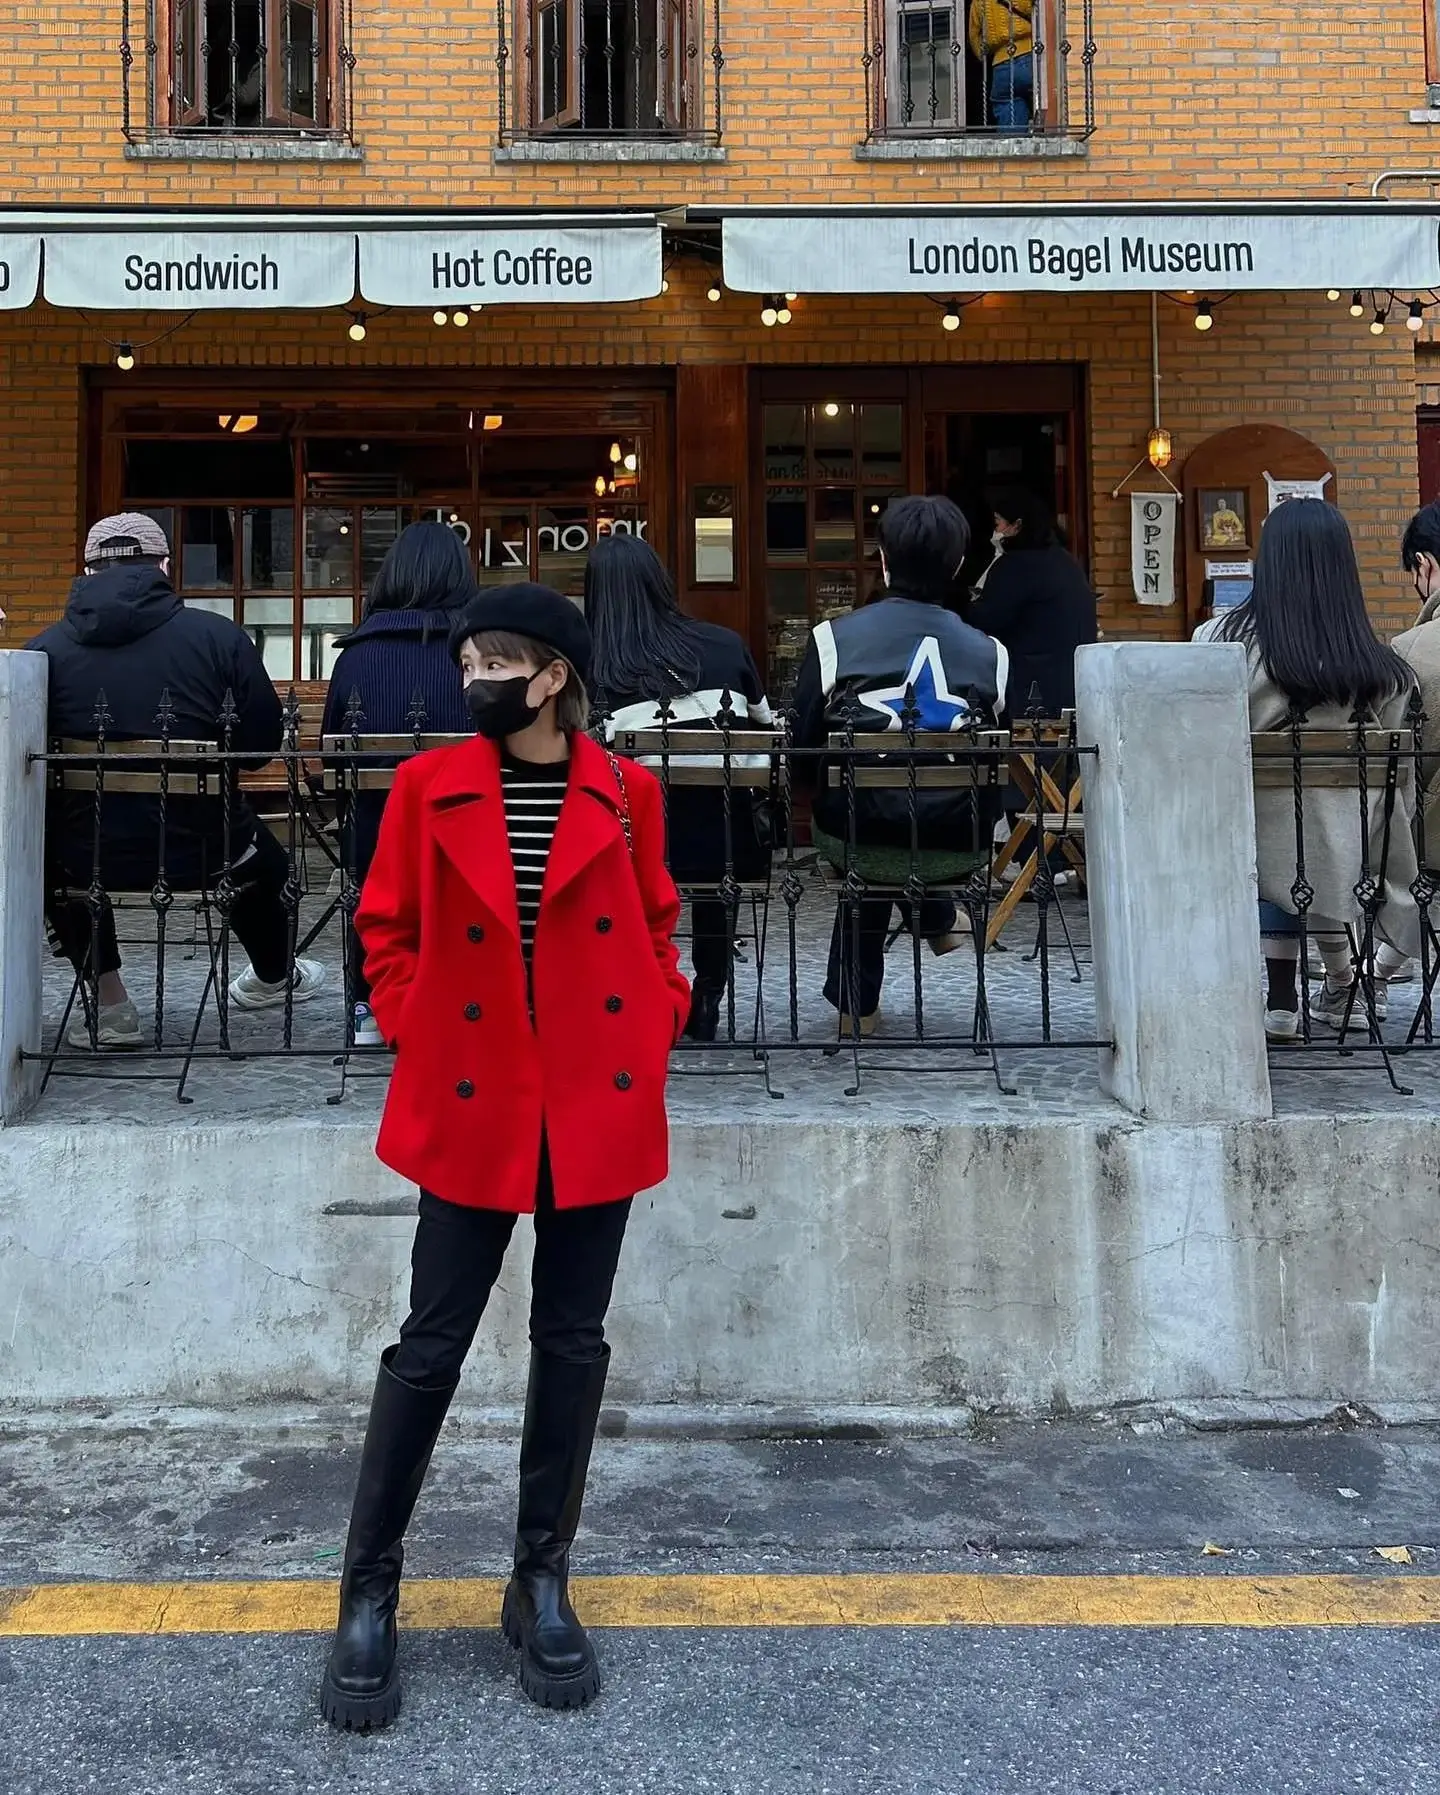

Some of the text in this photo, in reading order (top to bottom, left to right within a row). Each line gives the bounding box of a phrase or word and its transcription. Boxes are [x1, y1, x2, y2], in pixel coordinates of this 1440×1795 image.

[124, 253, 279, 292] Sandwich
[432, 247, 592, 289] Hot Coffee
[908, 236, 1254, 282] London Bagel Museum
[1142, 500, 1163, 594] OPEN
